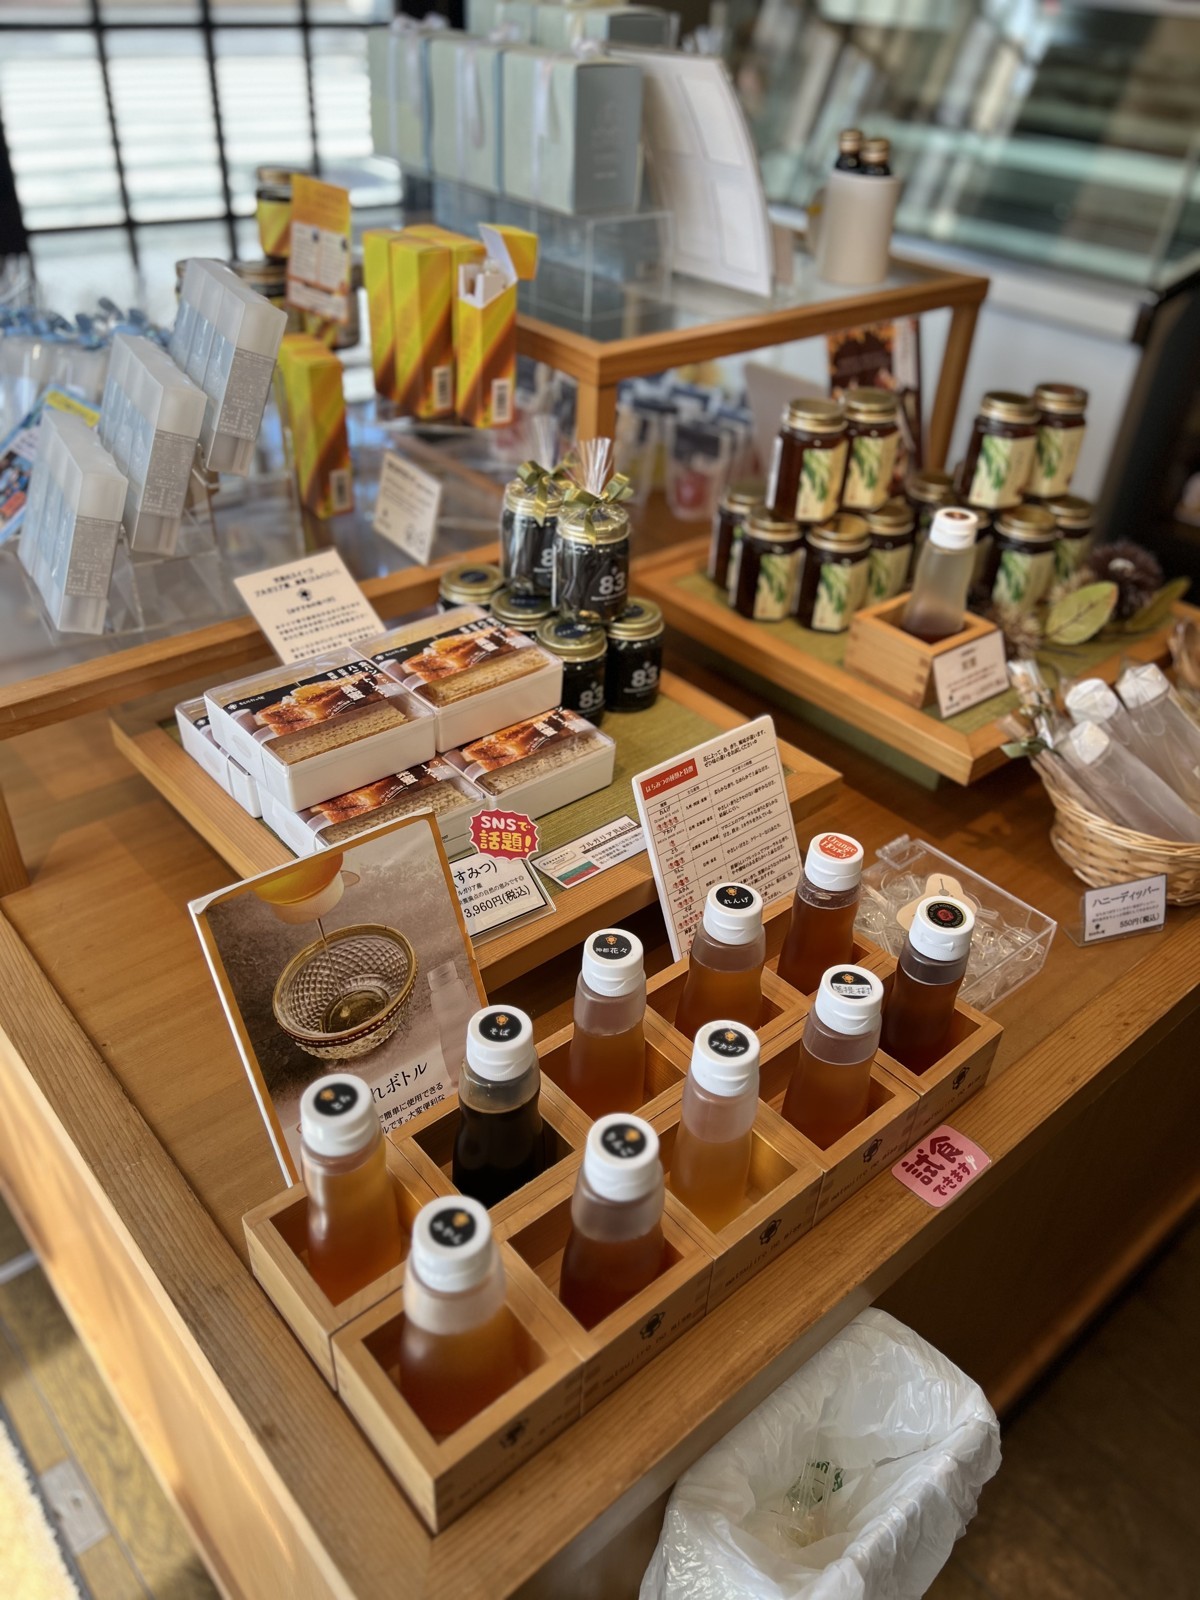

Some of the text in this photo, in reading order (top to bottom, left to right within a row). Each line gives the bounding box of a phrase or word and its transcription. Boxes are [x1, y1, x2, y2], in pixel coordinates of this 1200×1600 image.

[600, 570, 626, 595] 83
[631, 665, 659, 688] 83
[579, 684, 604, 708] 83
[481, 815, 531, 831] SNSで
[479, 830, 531, 852] 話題!
[821, 840, 850, 858] Honey
[828, 835, 857, 852] Orange
[463, 884, 531, 919] 3,960円(税込)
[723, 896, 749, 905] れんげ
[1092, 886, 1160, 907] ハニーディッパー
[489, 1026, 511, 1037] そば
[711, 1040, 745, 1053] アカシア
[901, 1135, 964, 1186] 試食
[932, 1161, 971, 1196] できます
